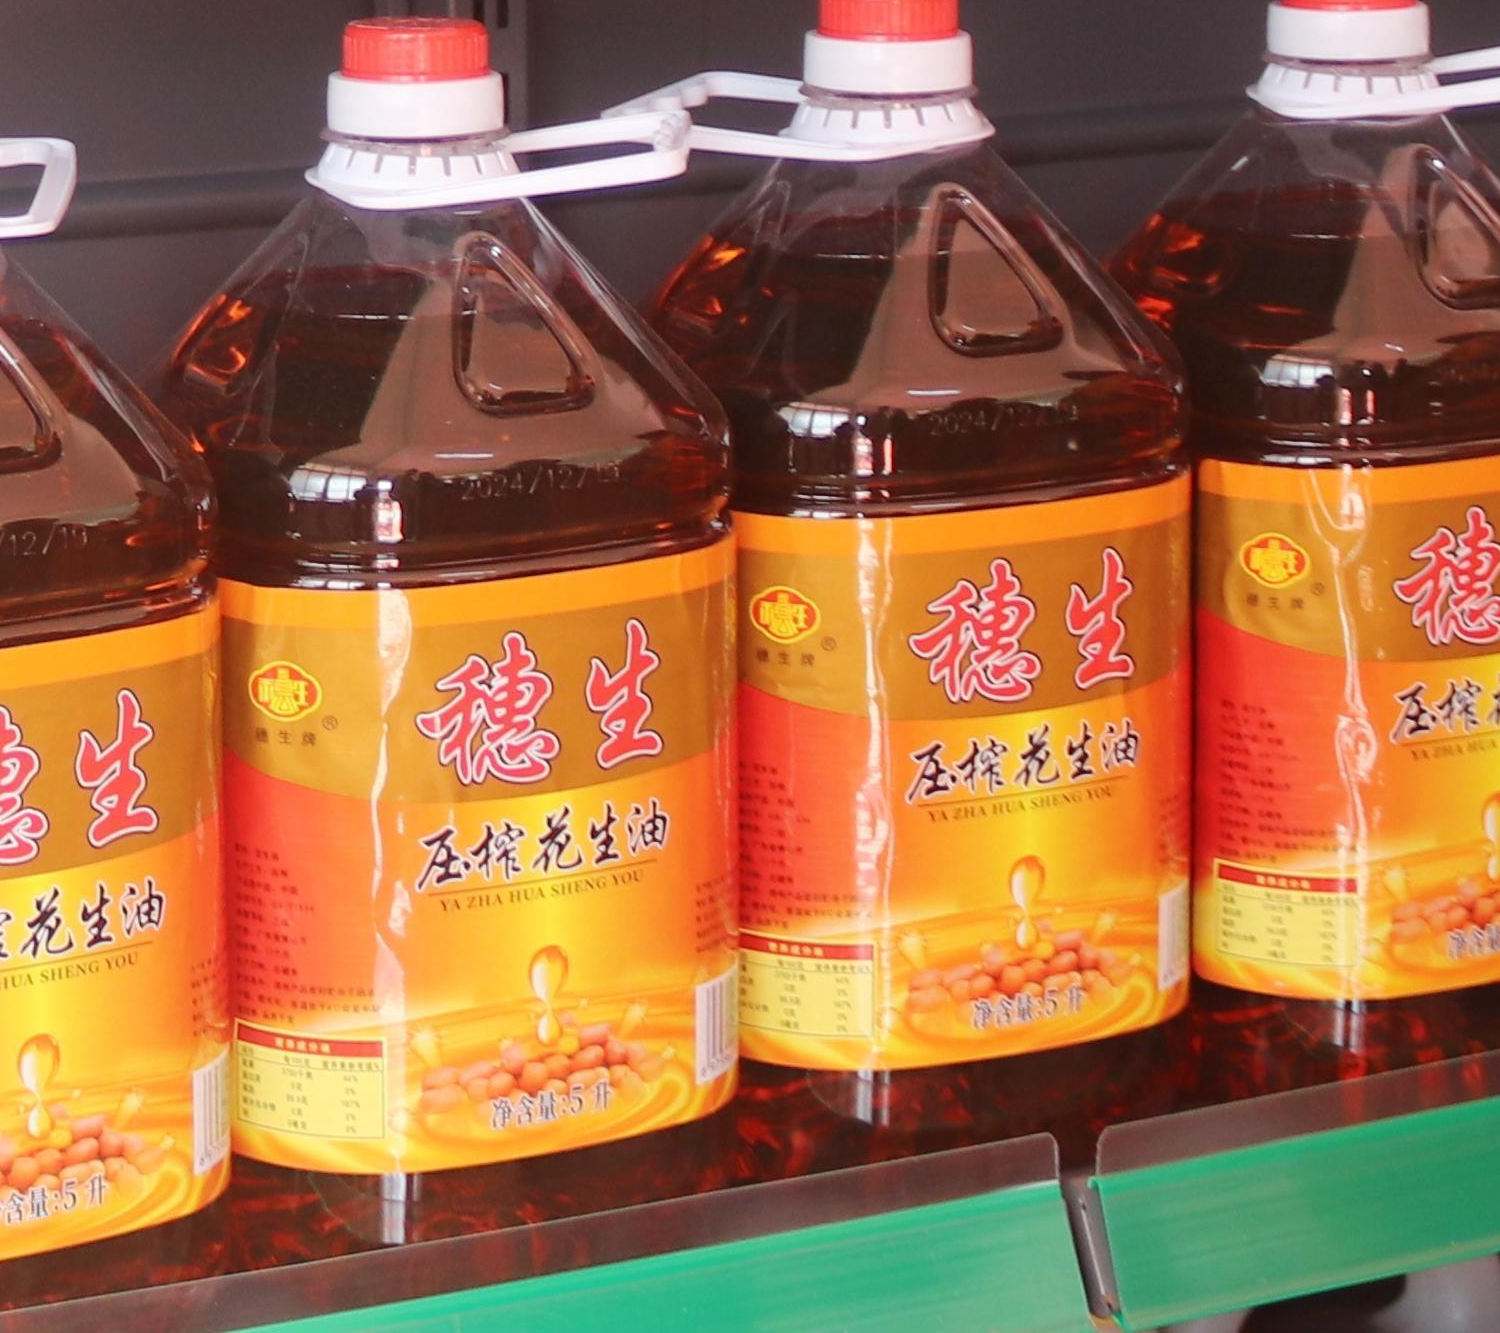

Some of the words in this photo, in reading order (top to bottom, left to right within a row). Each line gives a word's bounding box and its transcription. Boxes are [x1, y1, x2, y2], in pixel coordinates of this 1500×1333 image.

[907, 547, 1135, 704] 穗生
[416, 618, 665, 785] 穗生
[906, 717, 1140, 804] 压榨花生油
[417, 798, 671, 893] 压榨花生油
[440, 899, 461, 912] YA
[468, 893, 502, 909] ZHA
[509, 887, 545, 904] HUA
[551, 879, 606, 899] SHENG
[612, 870, 645, 887] YOU
[40, 963, 99, 985] SHENG
[105, 953, 139, 972] YOU
[492, 1082, 613, 1131] 净含量:5升
